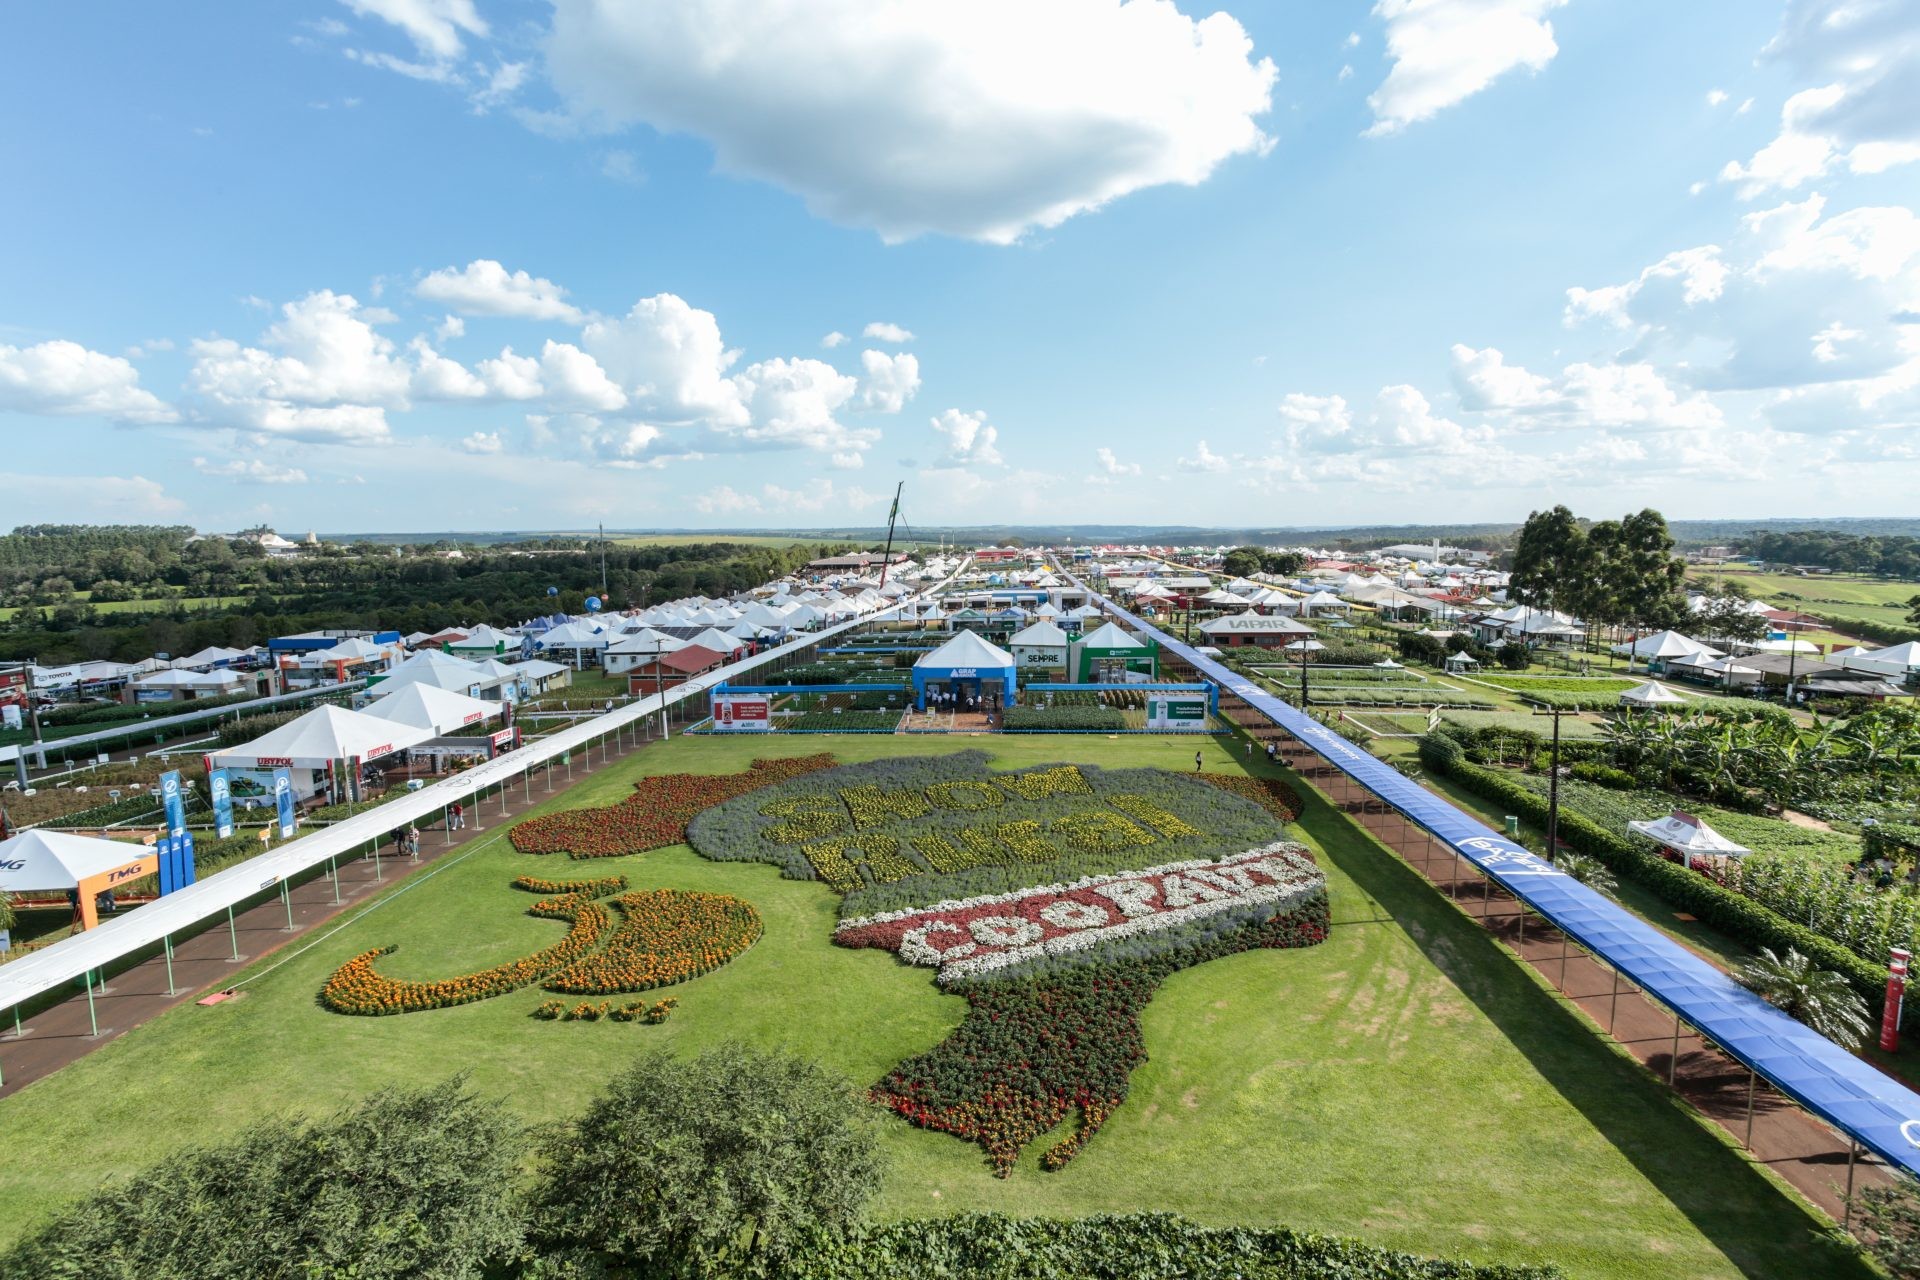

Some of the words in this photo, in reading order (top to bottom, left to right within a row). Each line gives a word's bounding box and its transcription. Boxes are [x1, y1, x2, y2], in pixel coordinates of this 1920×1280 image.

[1229, 620, 1288, 629] IAPAR
[1028, 654, 1059, 663] SEMPRE
[48, 672, 72, 680] TOYOTA
[0, 859, 26, 870] MG
[107, 864, 142, 883] TMG
[900, 850, 1323, 966] COOPAVEL
